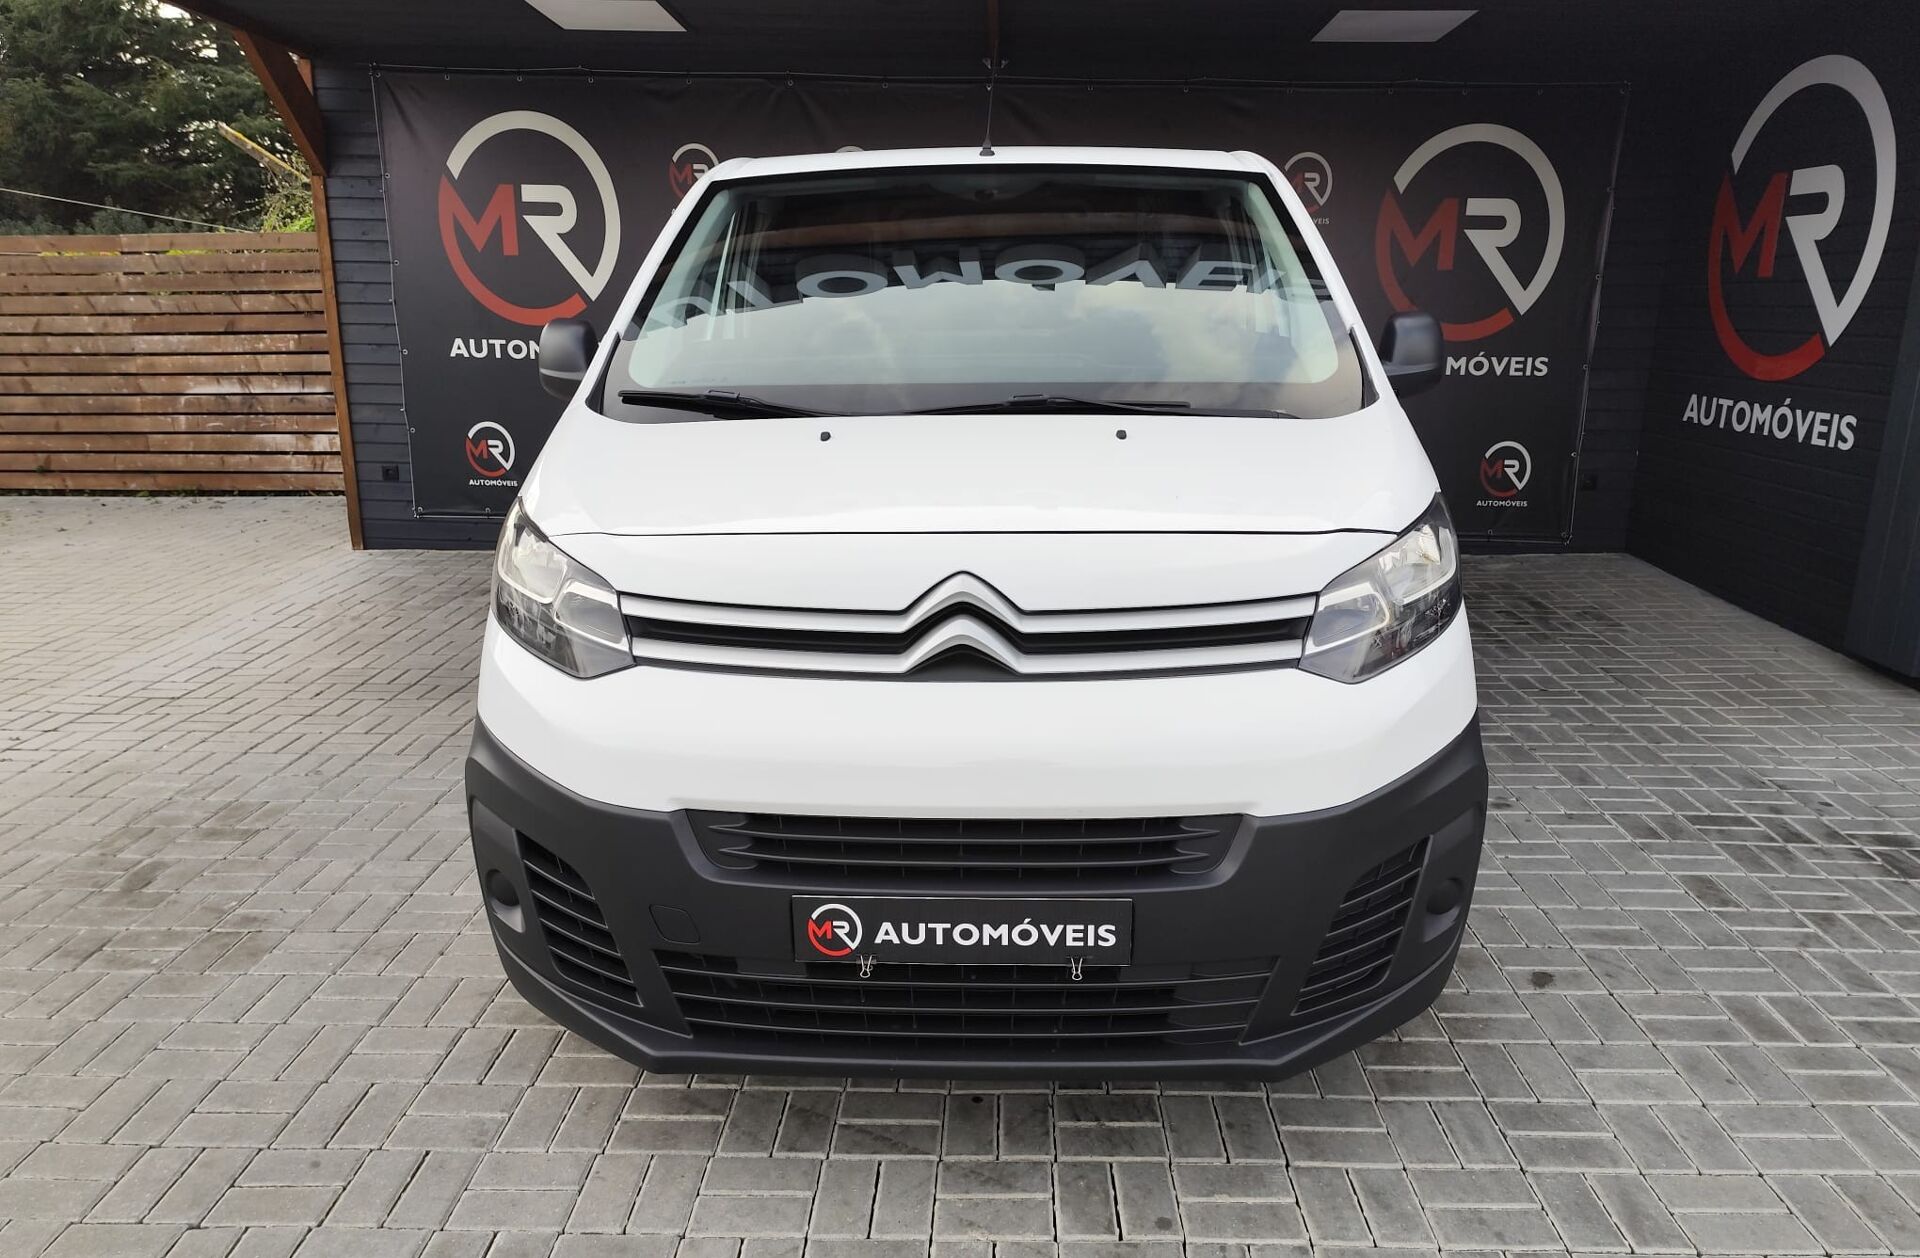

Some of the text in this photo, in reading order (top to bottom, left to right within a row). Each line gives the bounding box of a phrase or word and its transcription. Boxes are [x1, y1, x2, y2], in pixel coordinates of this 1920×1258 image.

[1445, 352, 1549, 377] MÓVEIS
[1682, 393, 1857, 451] AUTOMÓVEIS
[468, 478, 518, 487] AUTOMÓVEIS
[1476, 499, 1528, 507] AUTOMÓVEIS
[874, 917, 1116, 947] AUTOMÓVEIS
